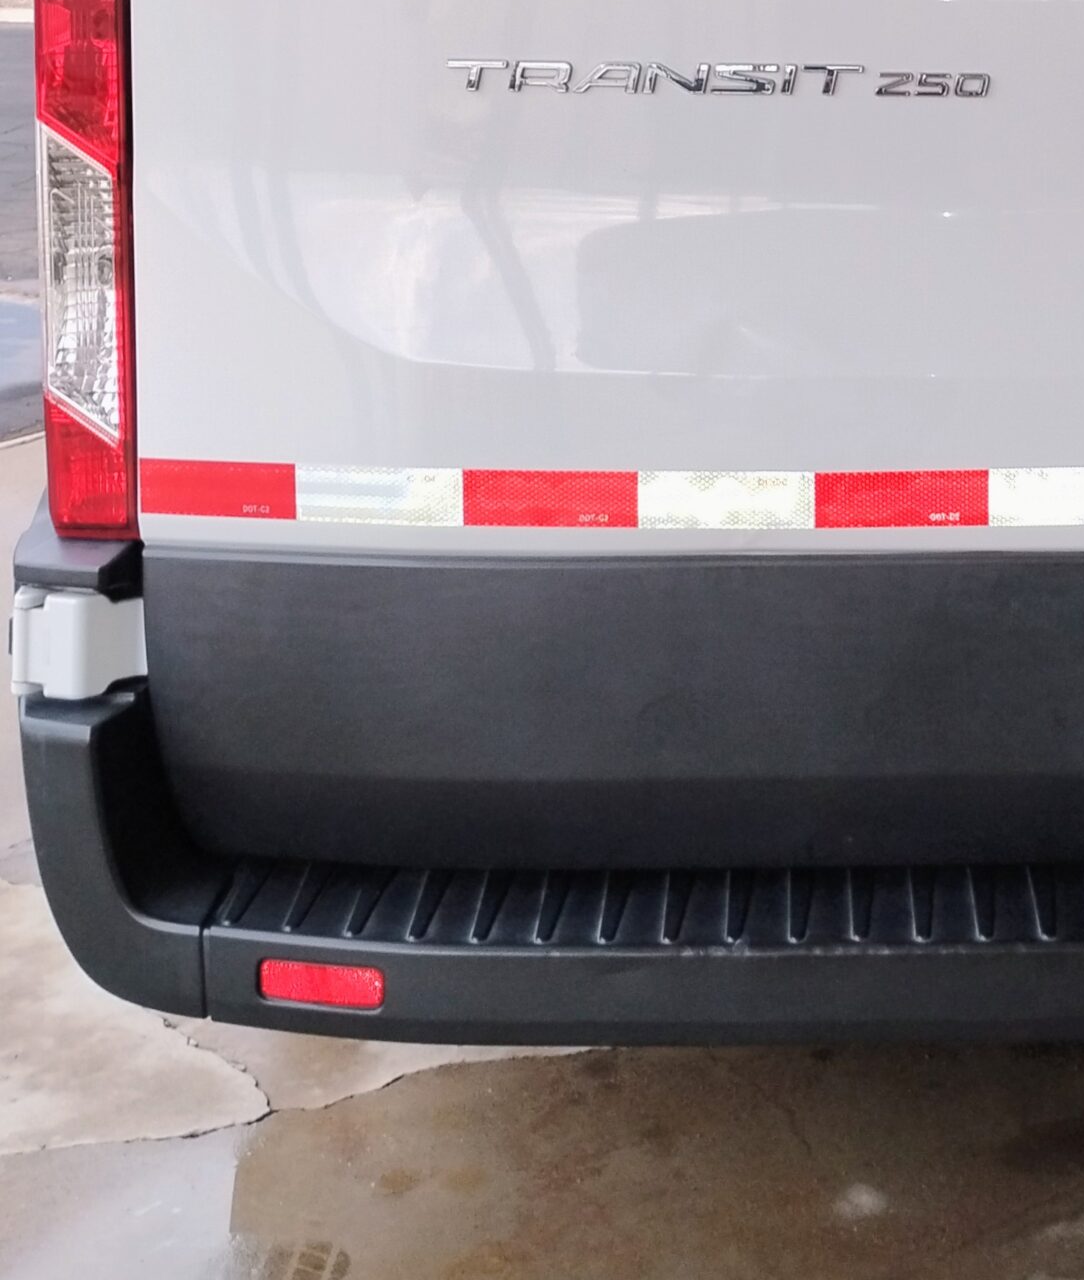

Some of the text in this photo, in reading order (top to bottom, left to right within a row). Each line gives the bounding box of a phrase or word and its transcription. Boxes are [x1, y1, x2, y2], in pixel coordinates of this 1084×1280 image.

[446, 59, 990, 97] TRANSIT 250
[242, 504, 270, 513] DOT-C2
